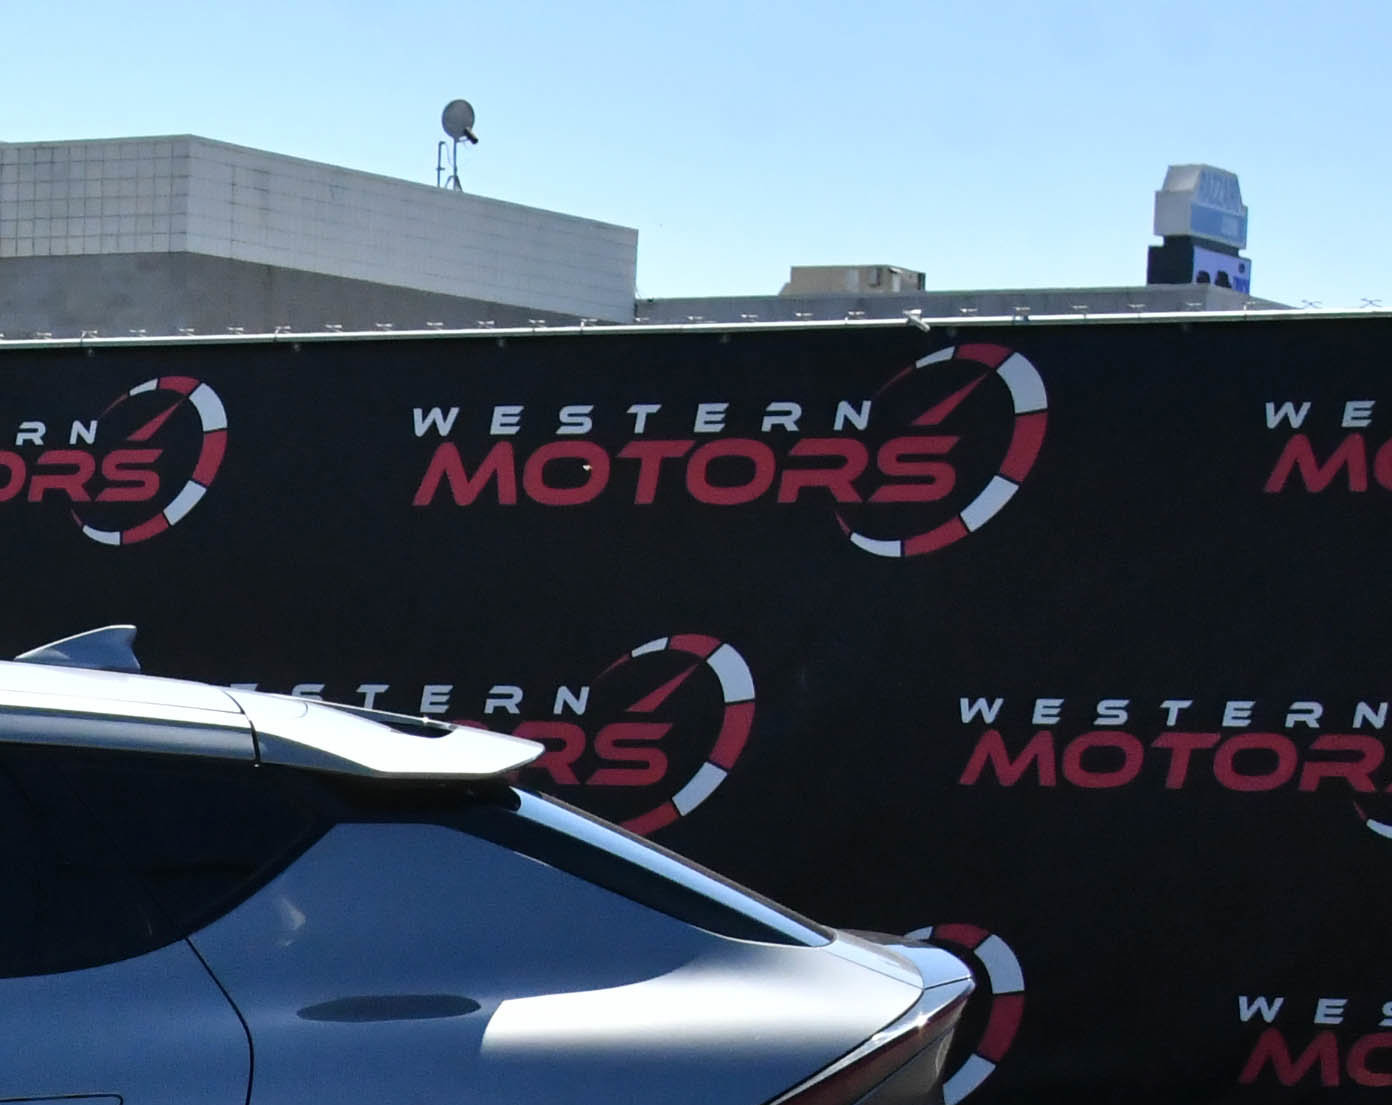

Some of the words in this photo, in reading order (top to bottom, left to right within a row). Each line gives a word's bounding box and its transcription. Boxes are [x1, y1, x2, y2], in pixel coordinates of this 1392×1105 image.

[413, 400, 872, 437] WESTERN
[413, 435, 960, 506] MOTORS
[1265, 433, 1392, 493] M
[960, 697, 1388, 729] WESTERN
[958, 729, 1392, 793] MOTOR
